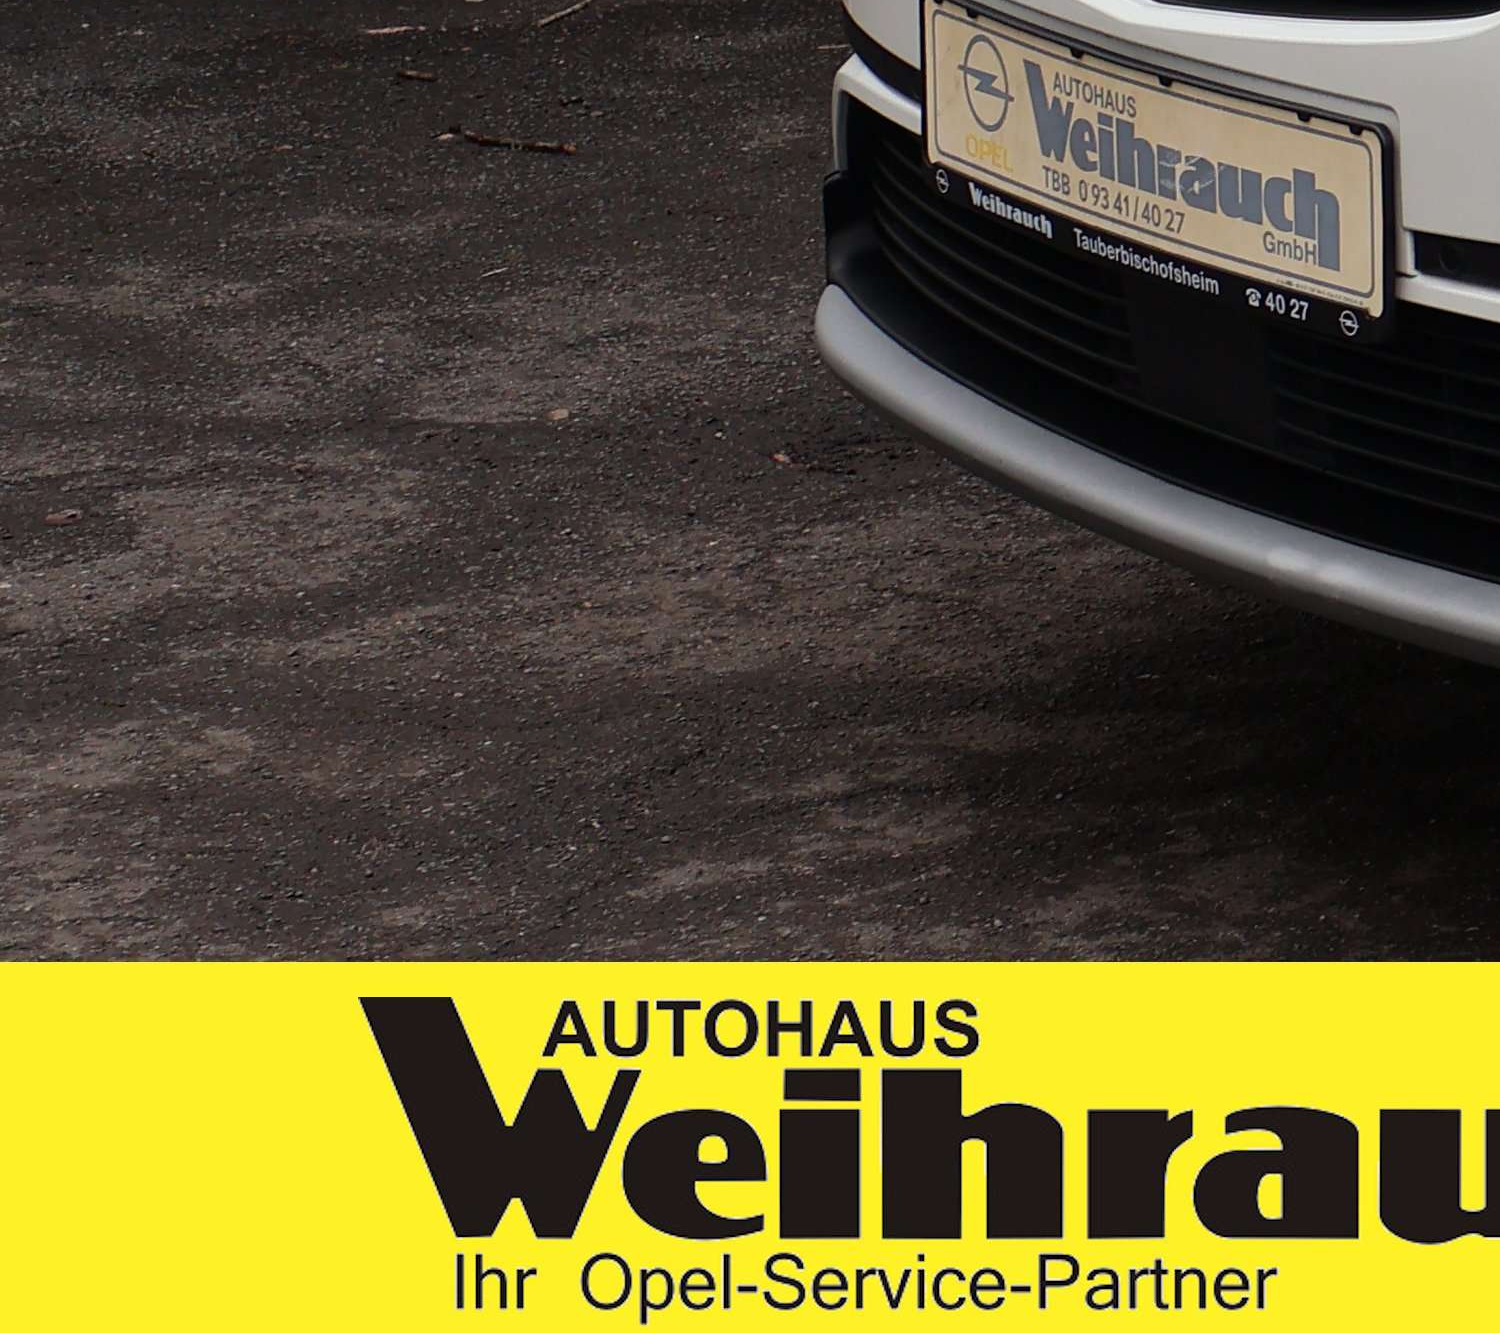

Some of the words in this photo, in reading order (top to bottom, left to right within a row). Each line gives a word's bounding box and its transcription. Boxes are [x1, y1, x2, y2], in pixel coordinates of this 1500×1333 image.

[1053, 72, 1137, 118] AUTOHAUS
[964, 133, 1014, 172] OPEL
[1023, 59, 1340, 272] Weihrauch
[1042, 165, 1071, 195] TBB
[968, 181, 1053, 239] Weihrauch
[1073, 227, 1220, 295] Tauberbischofsheim
[1265, 292, 1286, 315] 40
[1289, 299, 1309, 321] 27
[1263, 230, 1317, 266] GmbH
